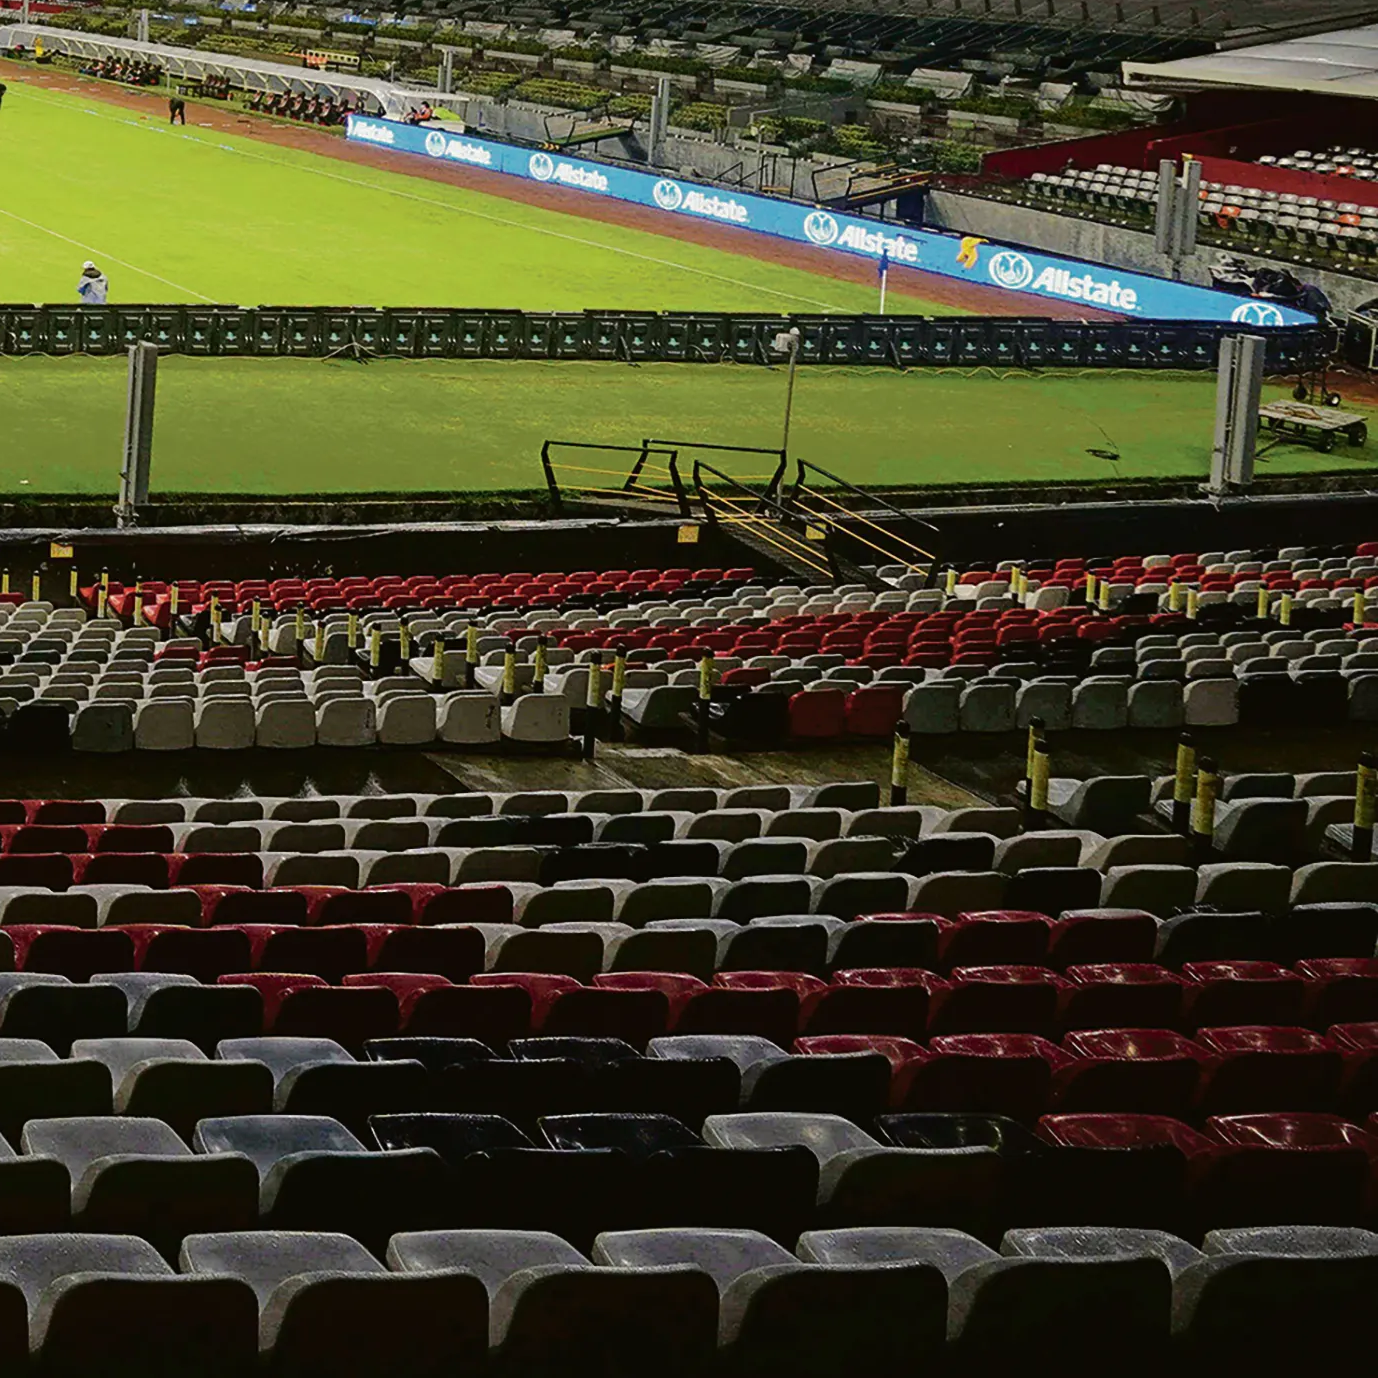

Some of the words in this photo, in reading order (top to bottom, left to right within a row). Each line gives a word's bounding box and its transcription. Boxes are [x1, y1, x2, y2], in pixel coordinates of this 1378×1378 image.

[553, 162, 609, 191] Allstate
[681, 189, 748, 223] Allstate
[837, 225, 921, 262] Allstate
[1031, 266, 1141, 312] Allstate
